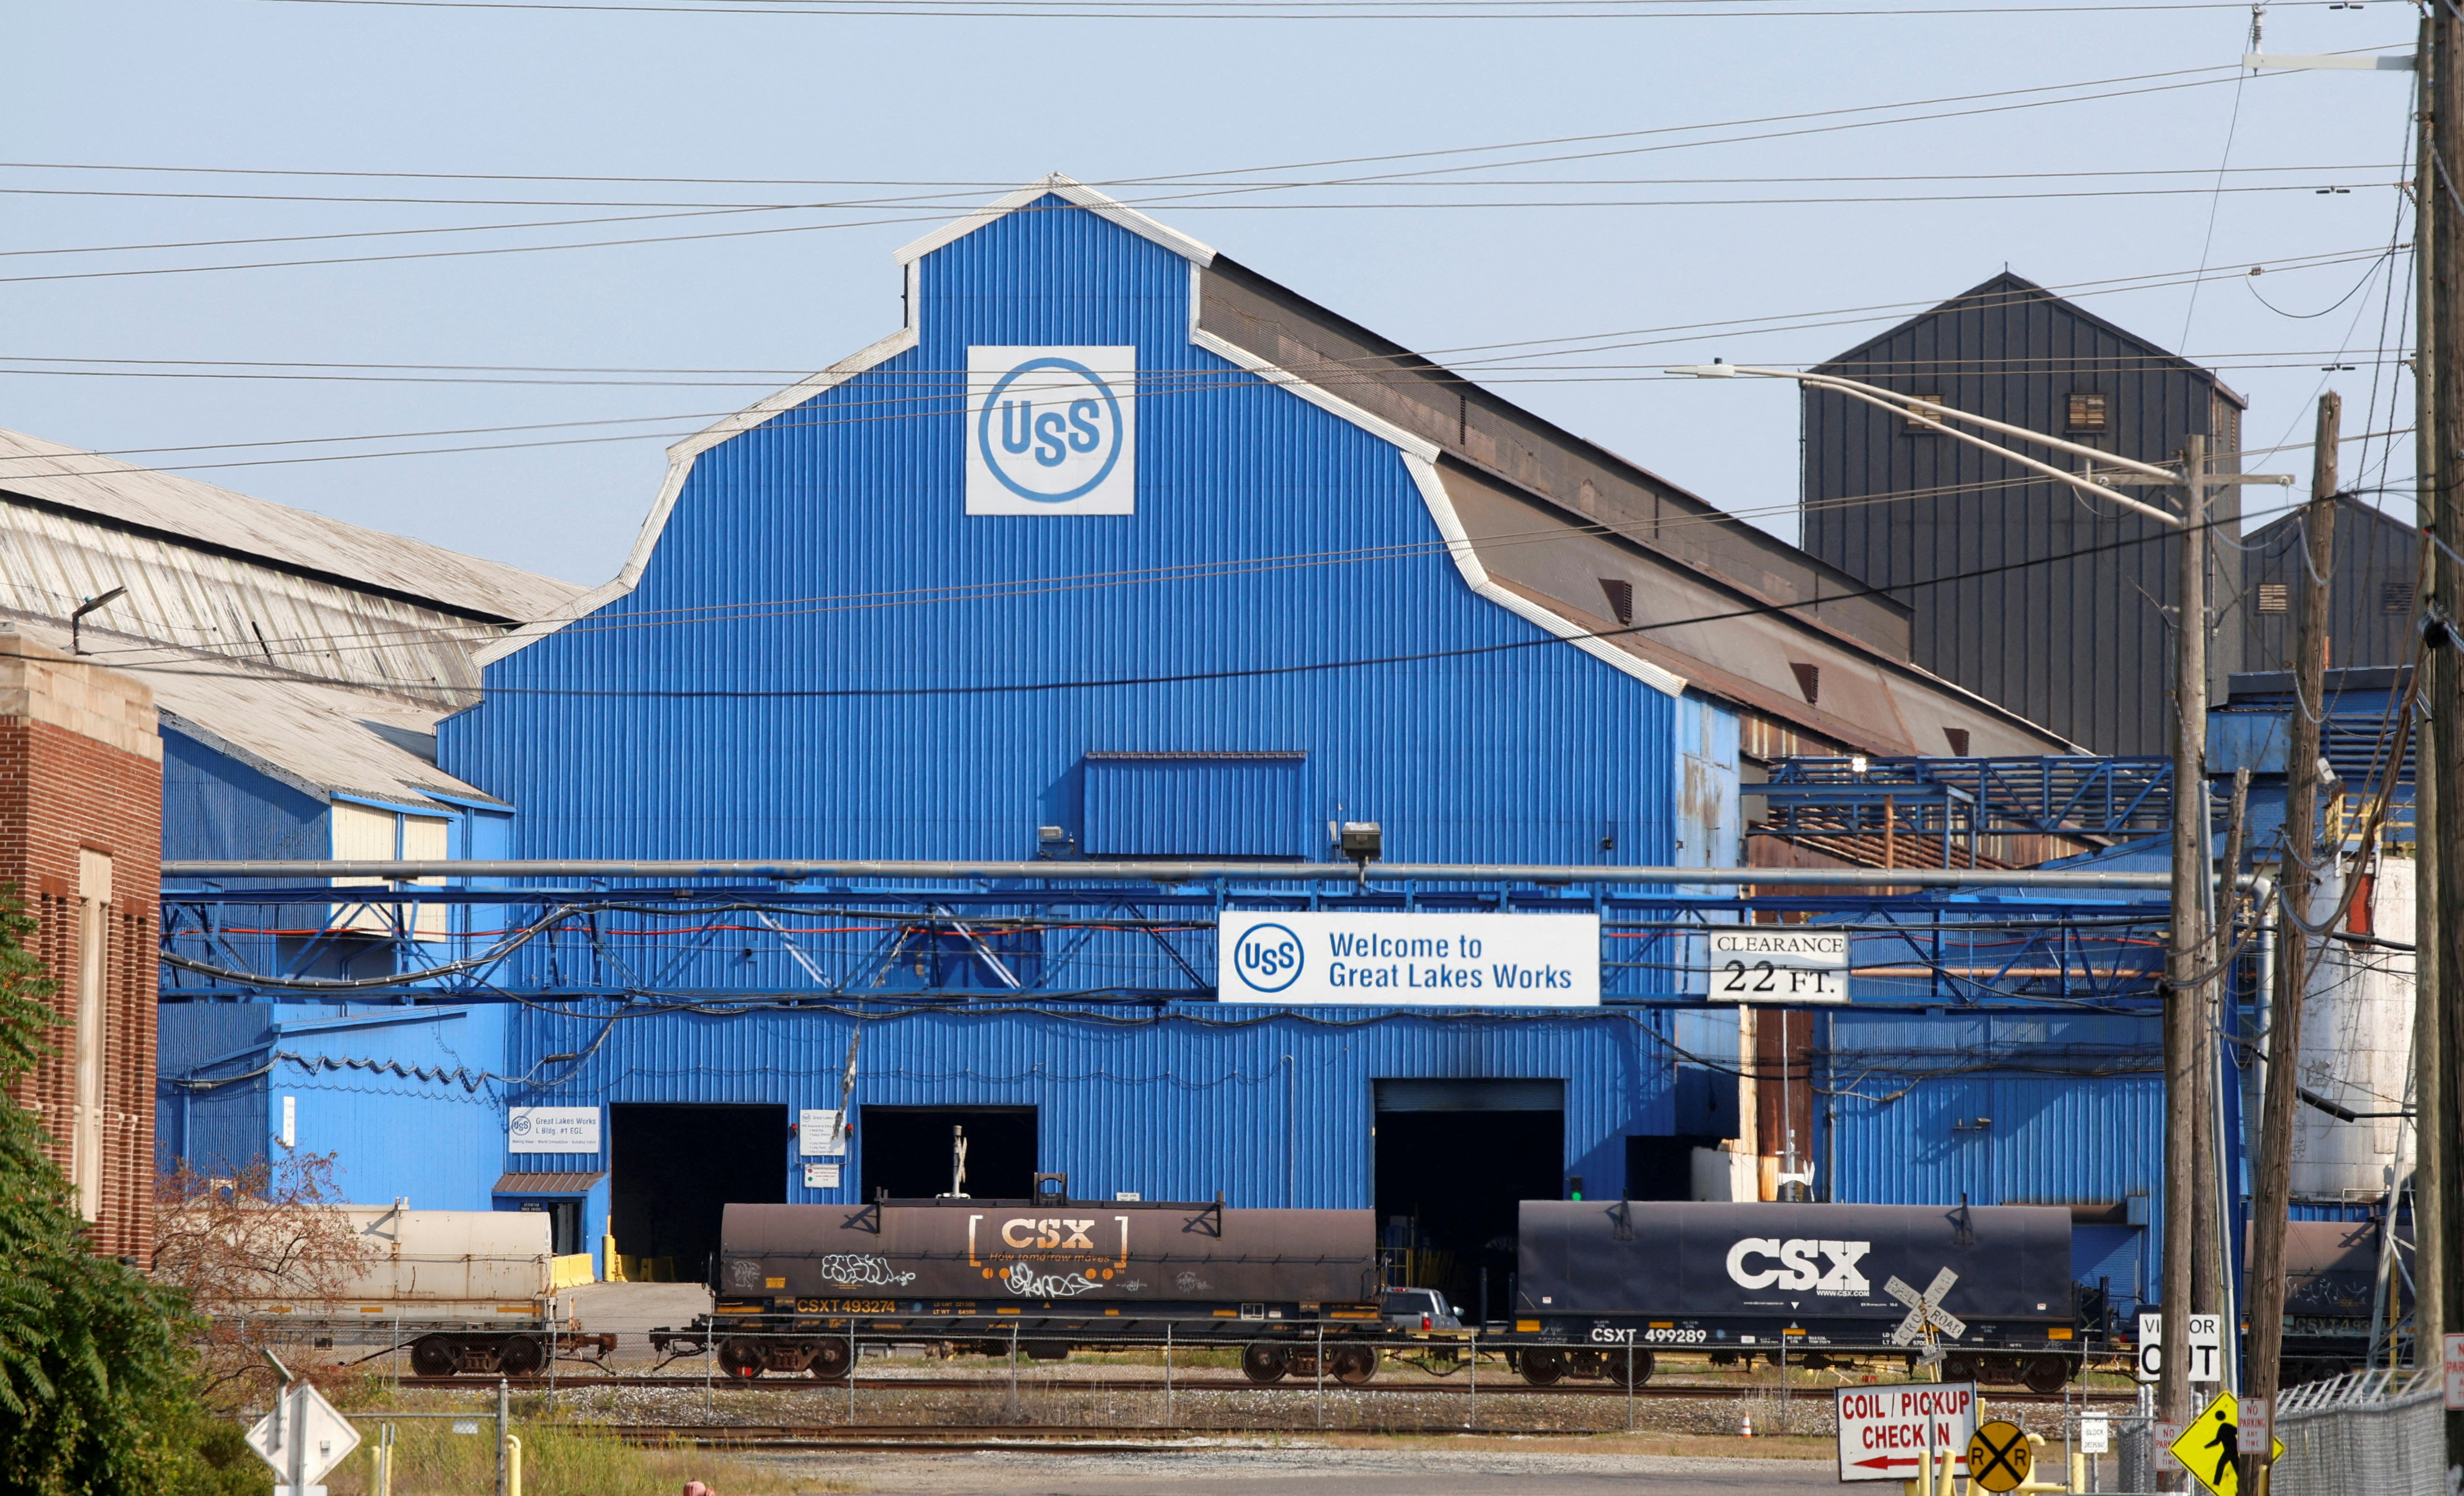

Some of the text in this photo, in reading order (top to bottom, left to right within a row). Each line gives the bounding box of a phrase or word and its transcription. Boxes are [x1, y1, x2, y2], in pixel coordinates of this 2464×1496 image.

[1002, 398, 1100, 468] USS
[1329, 932, 1482, 958] Welcome to
[1717, 936, 1843, 952] CLEARANCE
[1245, 942, 1294, 976] USS
[1329, 962, 1572, 989] Great Lakes Works
[1724, 960, 1835, 993] 22 FT.
[514, 1121, 528, 1131] USS
[1002, 1218, 1095, 1249] CSX
[1726, 1237, 1870, 1291] CSX
[797, 1299, 896, 1313] CSXT 493274
[1887, 1279, 1961, 1334] RAIL ROAD
[1591, 1328, 1707, 1343] CSXT 499289
[2145, 1319, 2215, 1334] VIOR
[1843, 1395, 1885, 1419] COIL
[1901, 1391, 1970, 1417] PICKUP
[2247, 1405, 2258, 1416] NO
[2163, 1429, 2175, 1438] NO
[2240, 1419, 2266, 1428] PARKING
[1862, 1424, 1926, 1449] CHECK
[1971, 1447, 2026, 1466] R R
